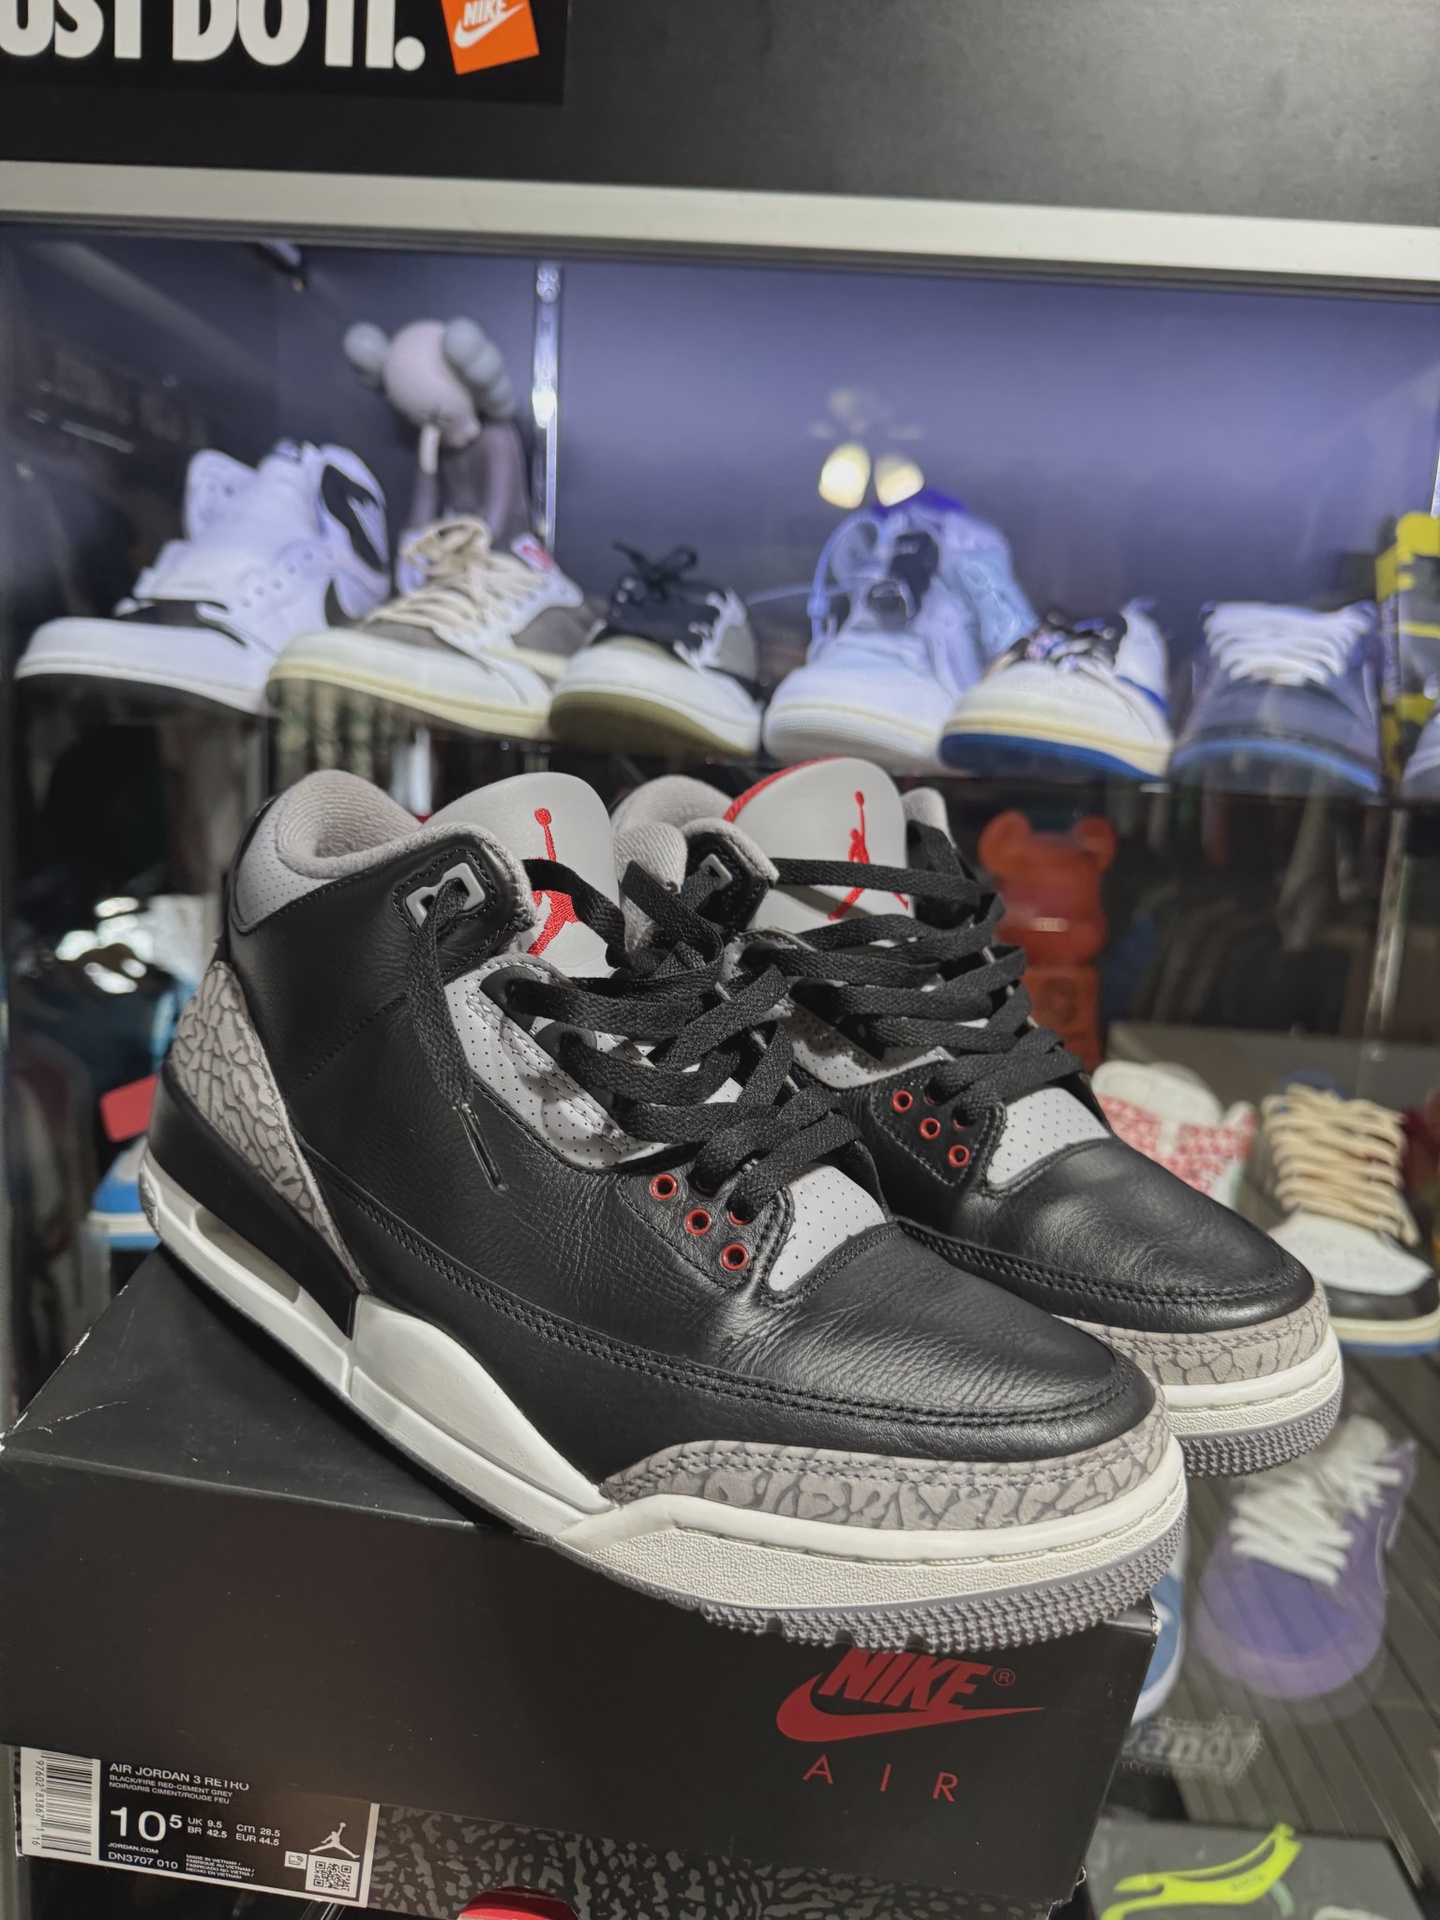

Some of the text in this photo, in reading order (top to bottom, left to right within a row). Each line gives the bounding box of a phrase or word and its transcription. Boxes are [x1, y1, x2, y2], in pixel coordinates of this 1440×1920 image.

[817, 1646, 992, 1711] NIKE
[109, 1763, 250, 1791] AIR JORDAN 3 RETRO
[109, 1774, 233, 1798] BLACK/FIRE RED-CEMENT GREY
[802, 1753, 959, 1802] AIR
[109, 1781, 230, 1805] NOIR/GRIS CIMENT/ROUGE FEU
[187, 1816, 281, 1838] UK 9.5 cm 28.5
[187, 1825, 280, 1847] BR 42.5 EUR 44.5
[107, 1842, 159, 1854] JORDAN.COM
[108, 1851, 178, 1870] DN3707 010
